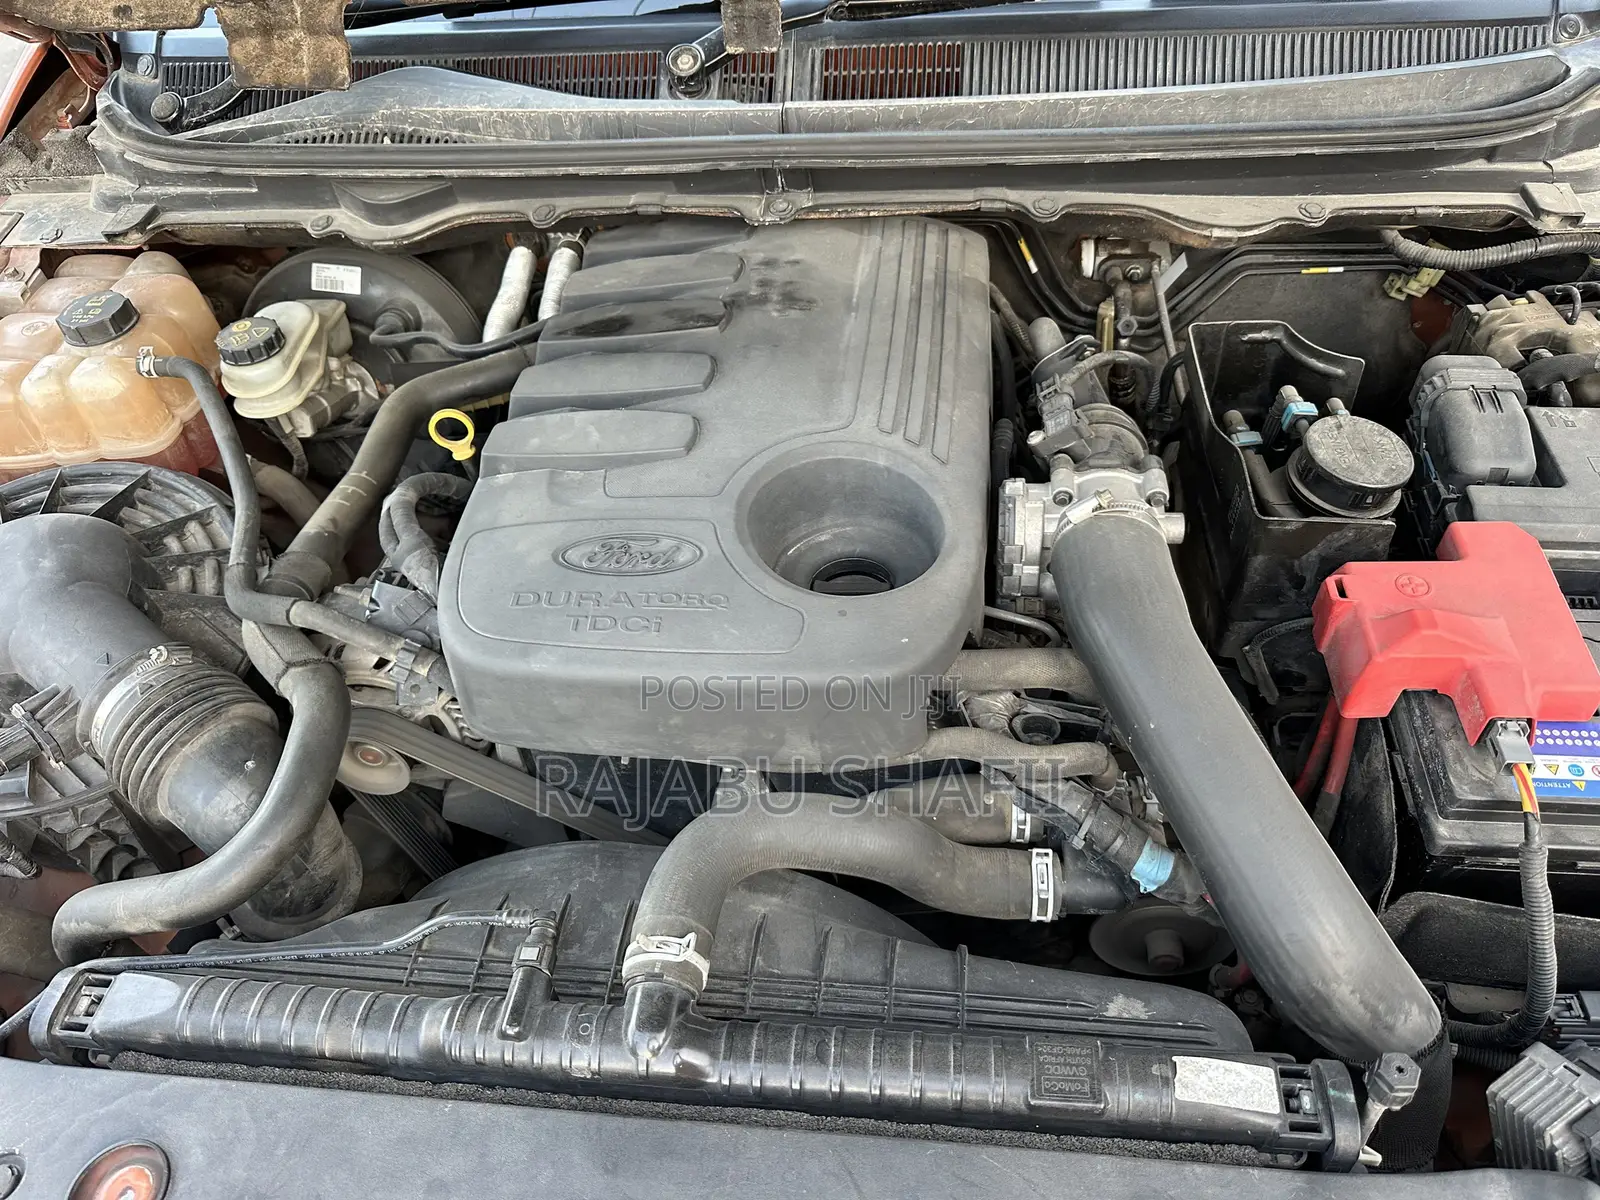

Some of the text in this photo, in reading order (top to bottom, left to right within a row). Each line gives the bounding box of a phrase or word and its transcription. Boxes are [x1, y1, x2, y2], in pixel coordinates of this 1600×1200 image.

[582, 537, 682, 569] Ford
[508, 591, 730, 610] DURATORQ
[565, 614, 663, 633] TDCi
[1038, 1054, 1092, 1065] SOUTH AFRICA
[1044, 1081, 1089, 1093] FoMoCo
